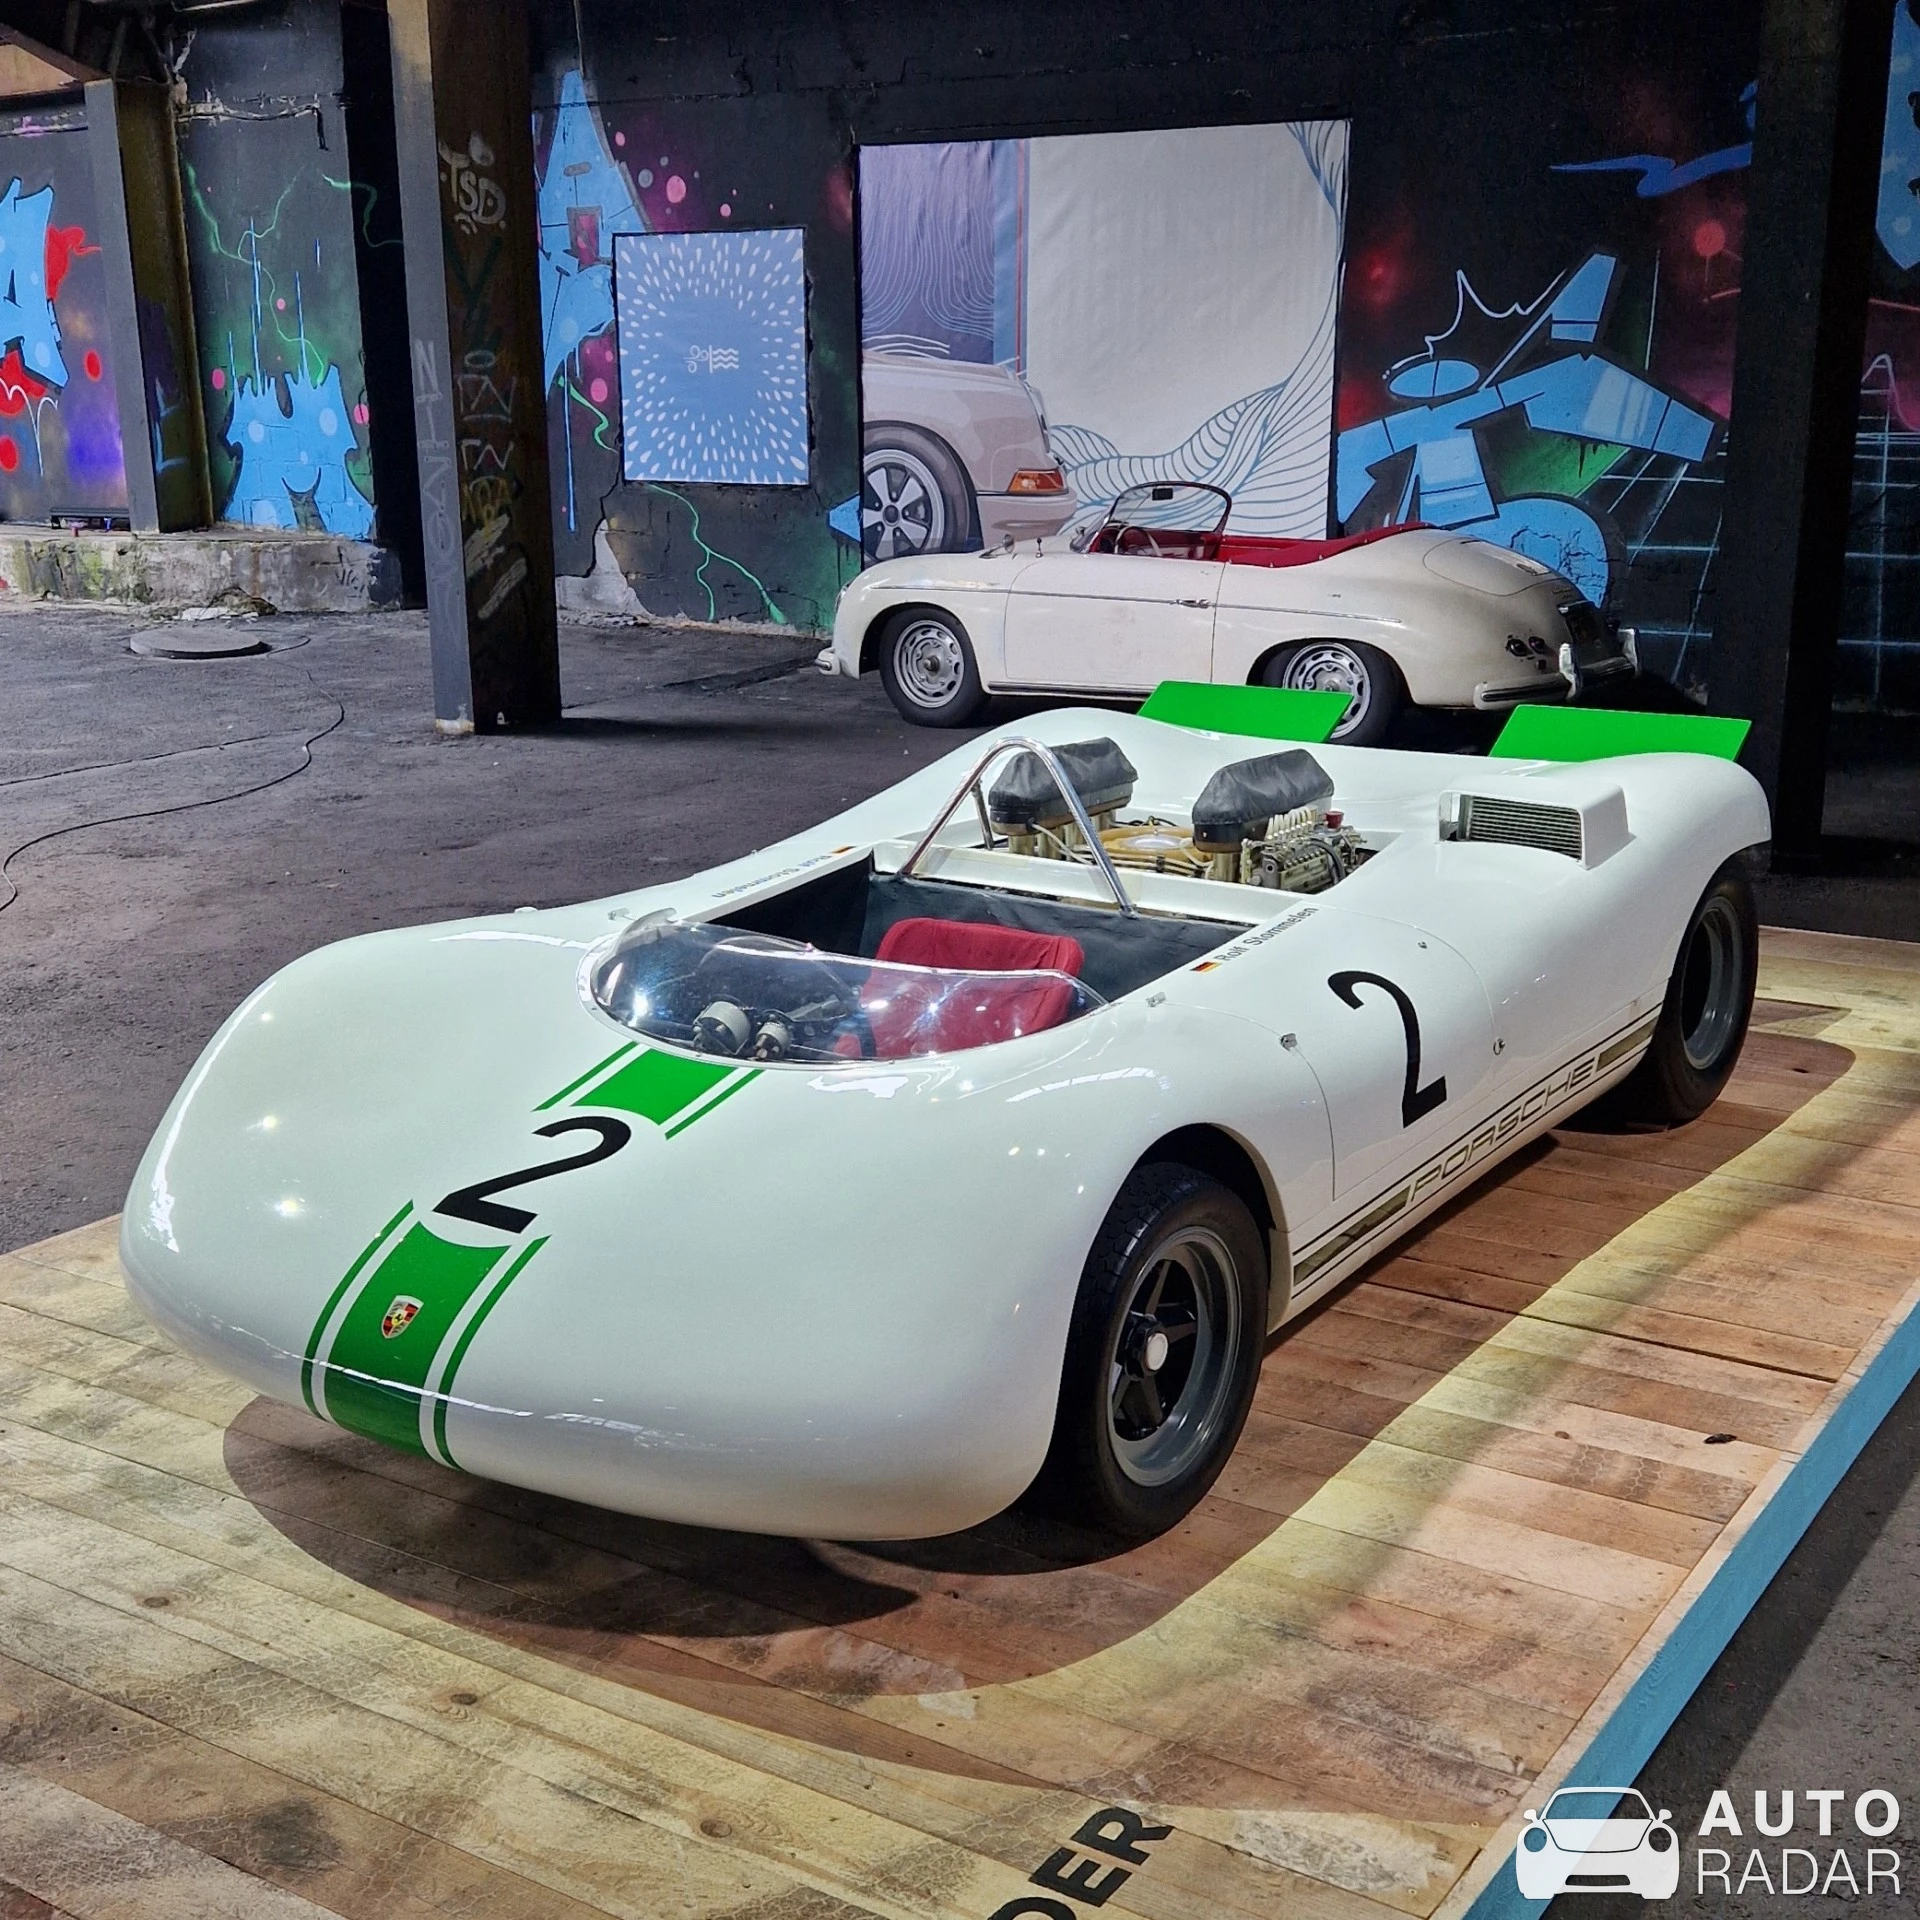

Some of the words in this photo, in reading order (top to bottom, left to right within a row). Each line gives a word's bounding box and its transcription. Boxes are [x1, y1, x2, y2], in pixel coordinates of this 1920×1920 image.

[1213, 945, 1251, 961] Rolf
[1243, 907, 1319, 946] Stommelen
[1327, 970, 1447, 1129] 2
[431, 1116, 632, 1234] 2
[1410, 1056, 1596, 1202] PORSCHE
